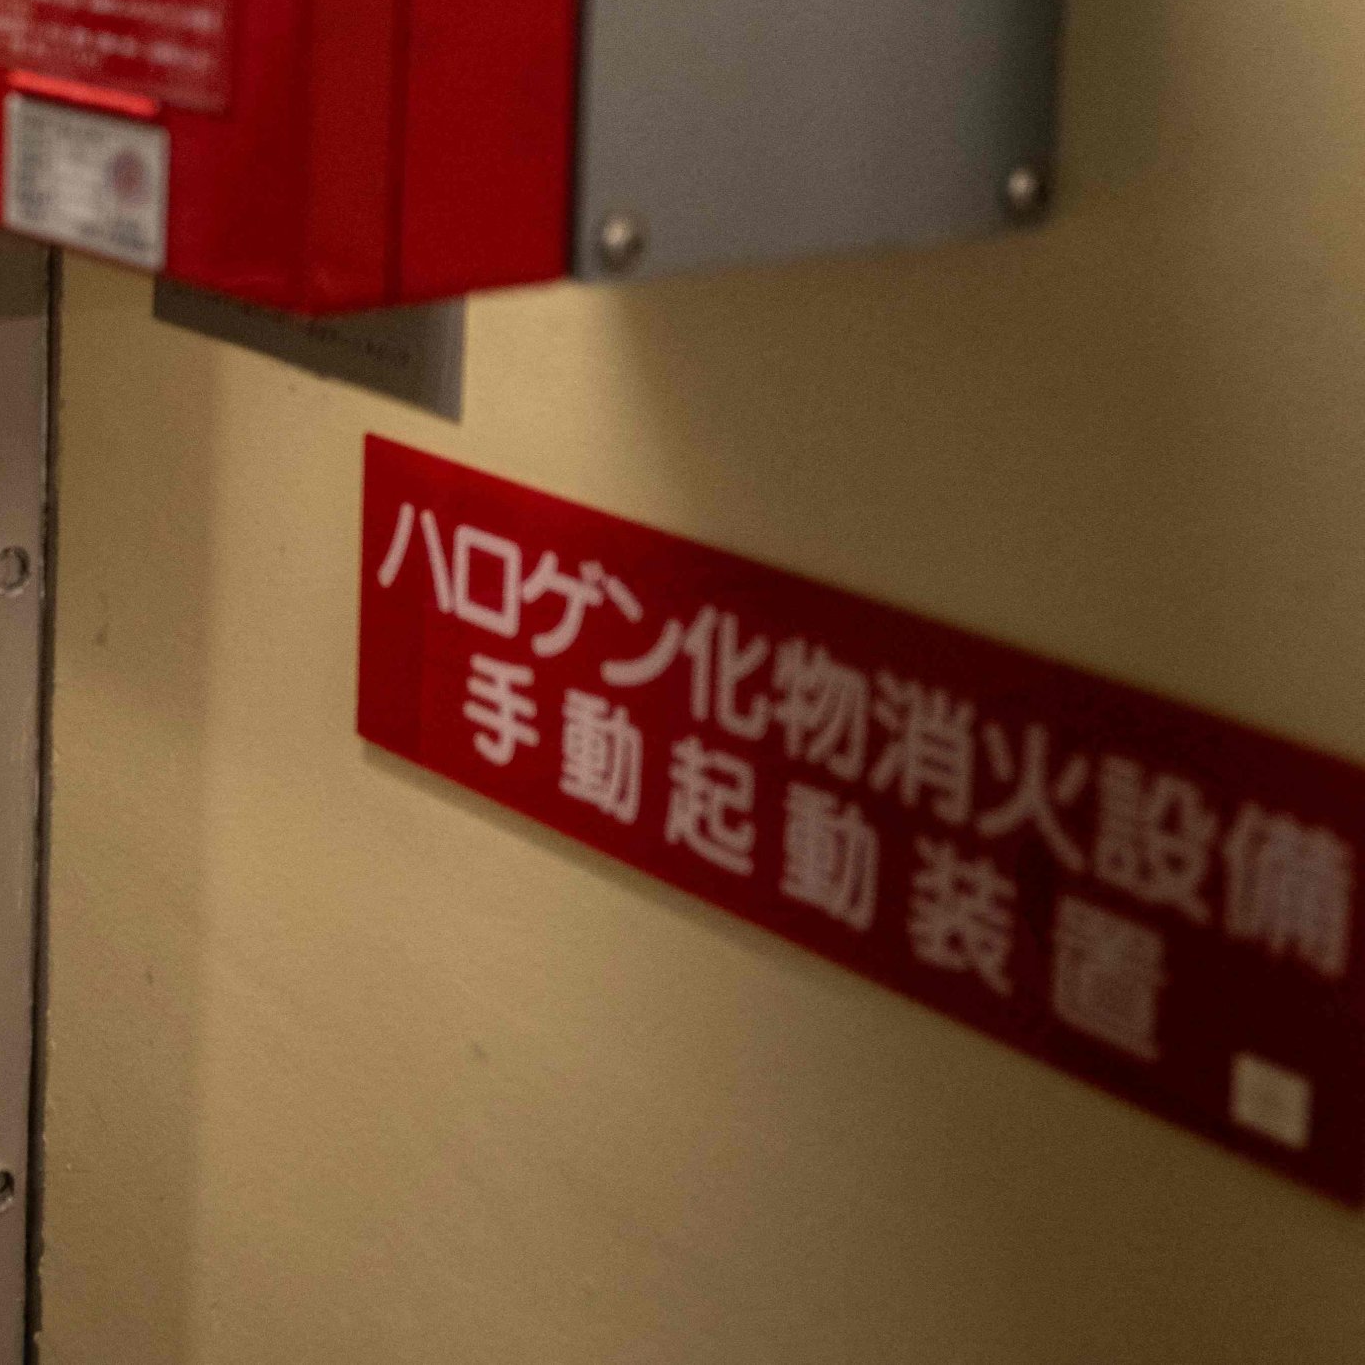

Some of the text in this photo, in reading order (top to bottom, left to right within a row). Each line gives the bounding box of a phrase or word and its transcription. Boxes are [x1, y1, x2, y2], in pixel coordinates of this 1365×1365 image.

[376, 501, 1353, 977] ハロゲン化物消火設備
[462, 653, 1167, 1063] 手動起動装置
